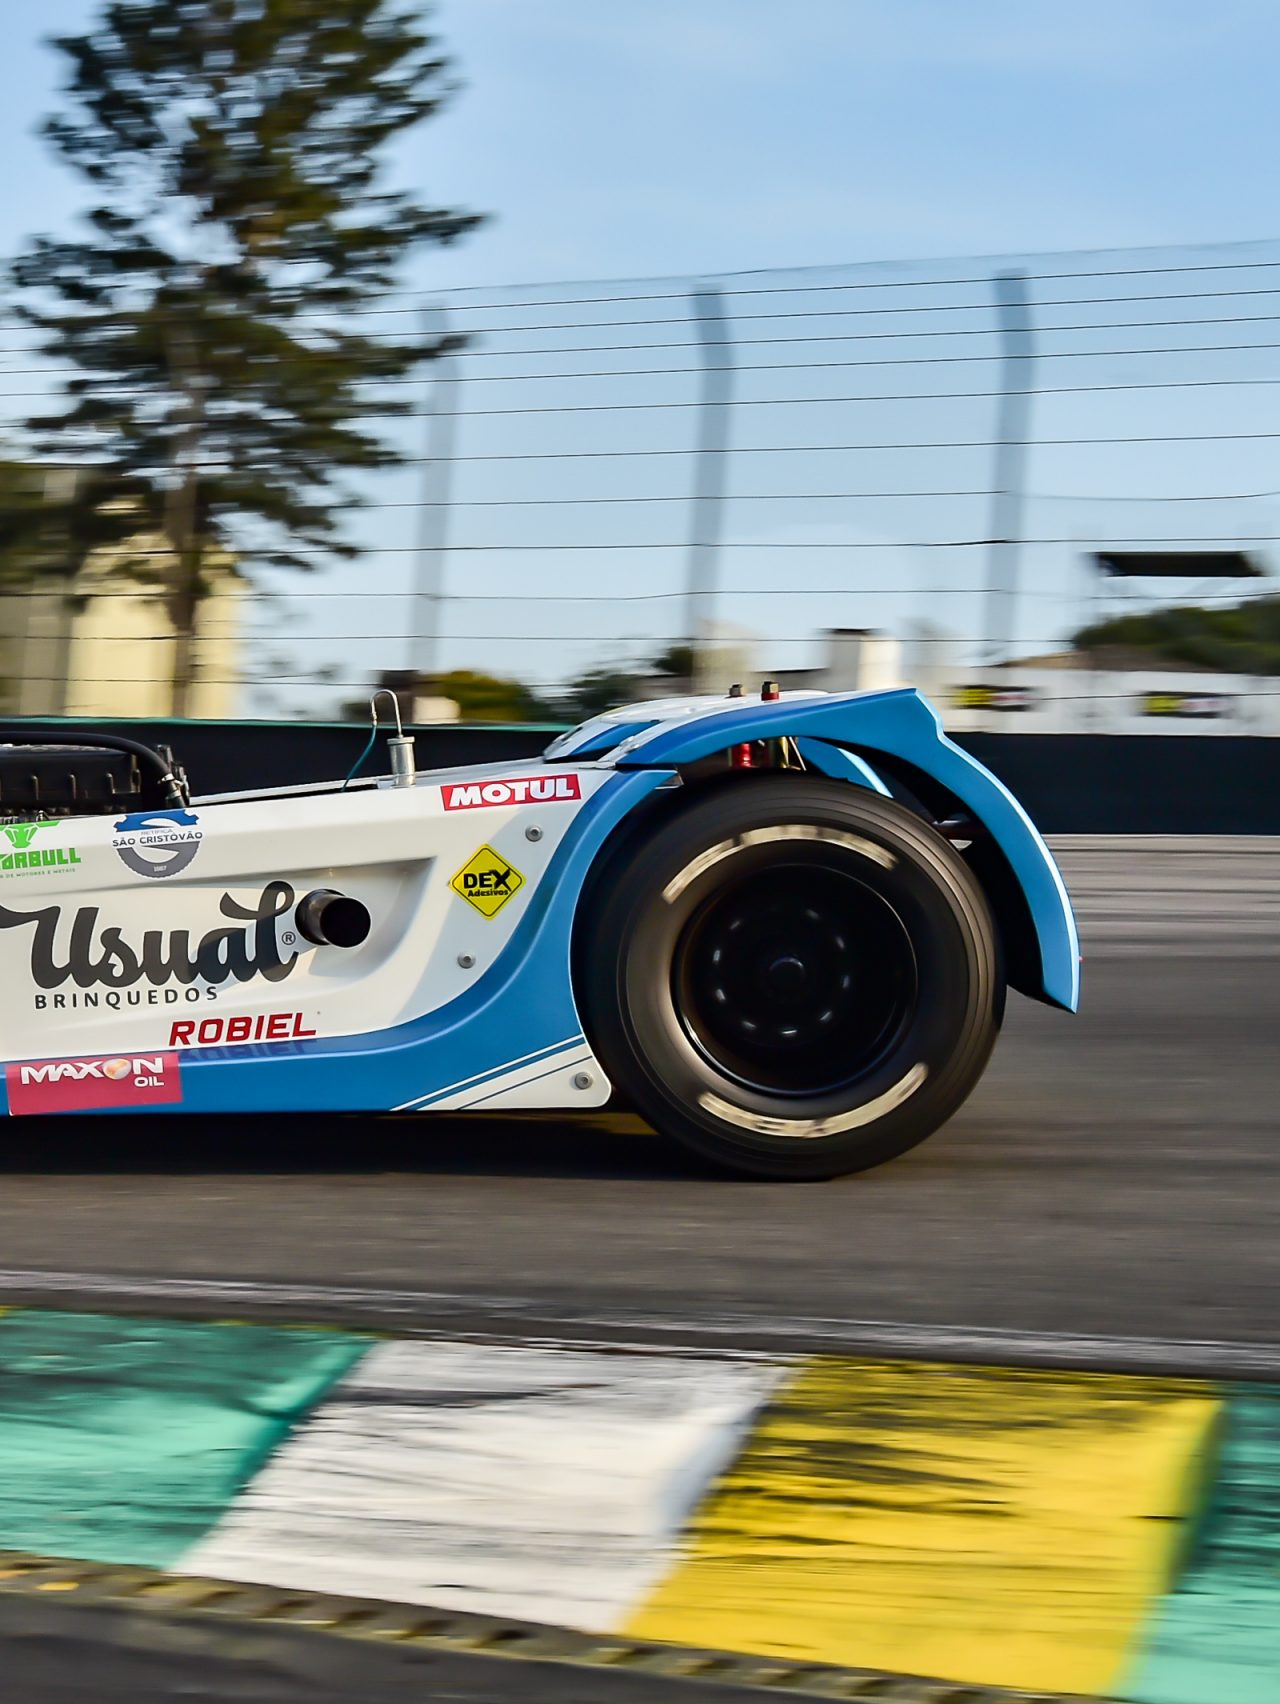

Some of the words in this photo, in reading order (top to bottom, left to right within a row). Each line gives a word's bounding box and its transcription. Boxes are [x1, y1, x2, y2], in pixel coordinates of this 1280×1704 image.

[450, 778, 574, 807] MOTUL
[112, 837, 136, 847] SÃO
[463, 868, 512, 892] DEX
[467, 889, 509, 897] Adesivos
[35, 985, 218, 1010] BRINQUEDOS
[169, 1013, 317, 1047] ROBIEL
[21, 1057, 164, 1084] MAXON
[133, 1076, 165, 1088] OIL
